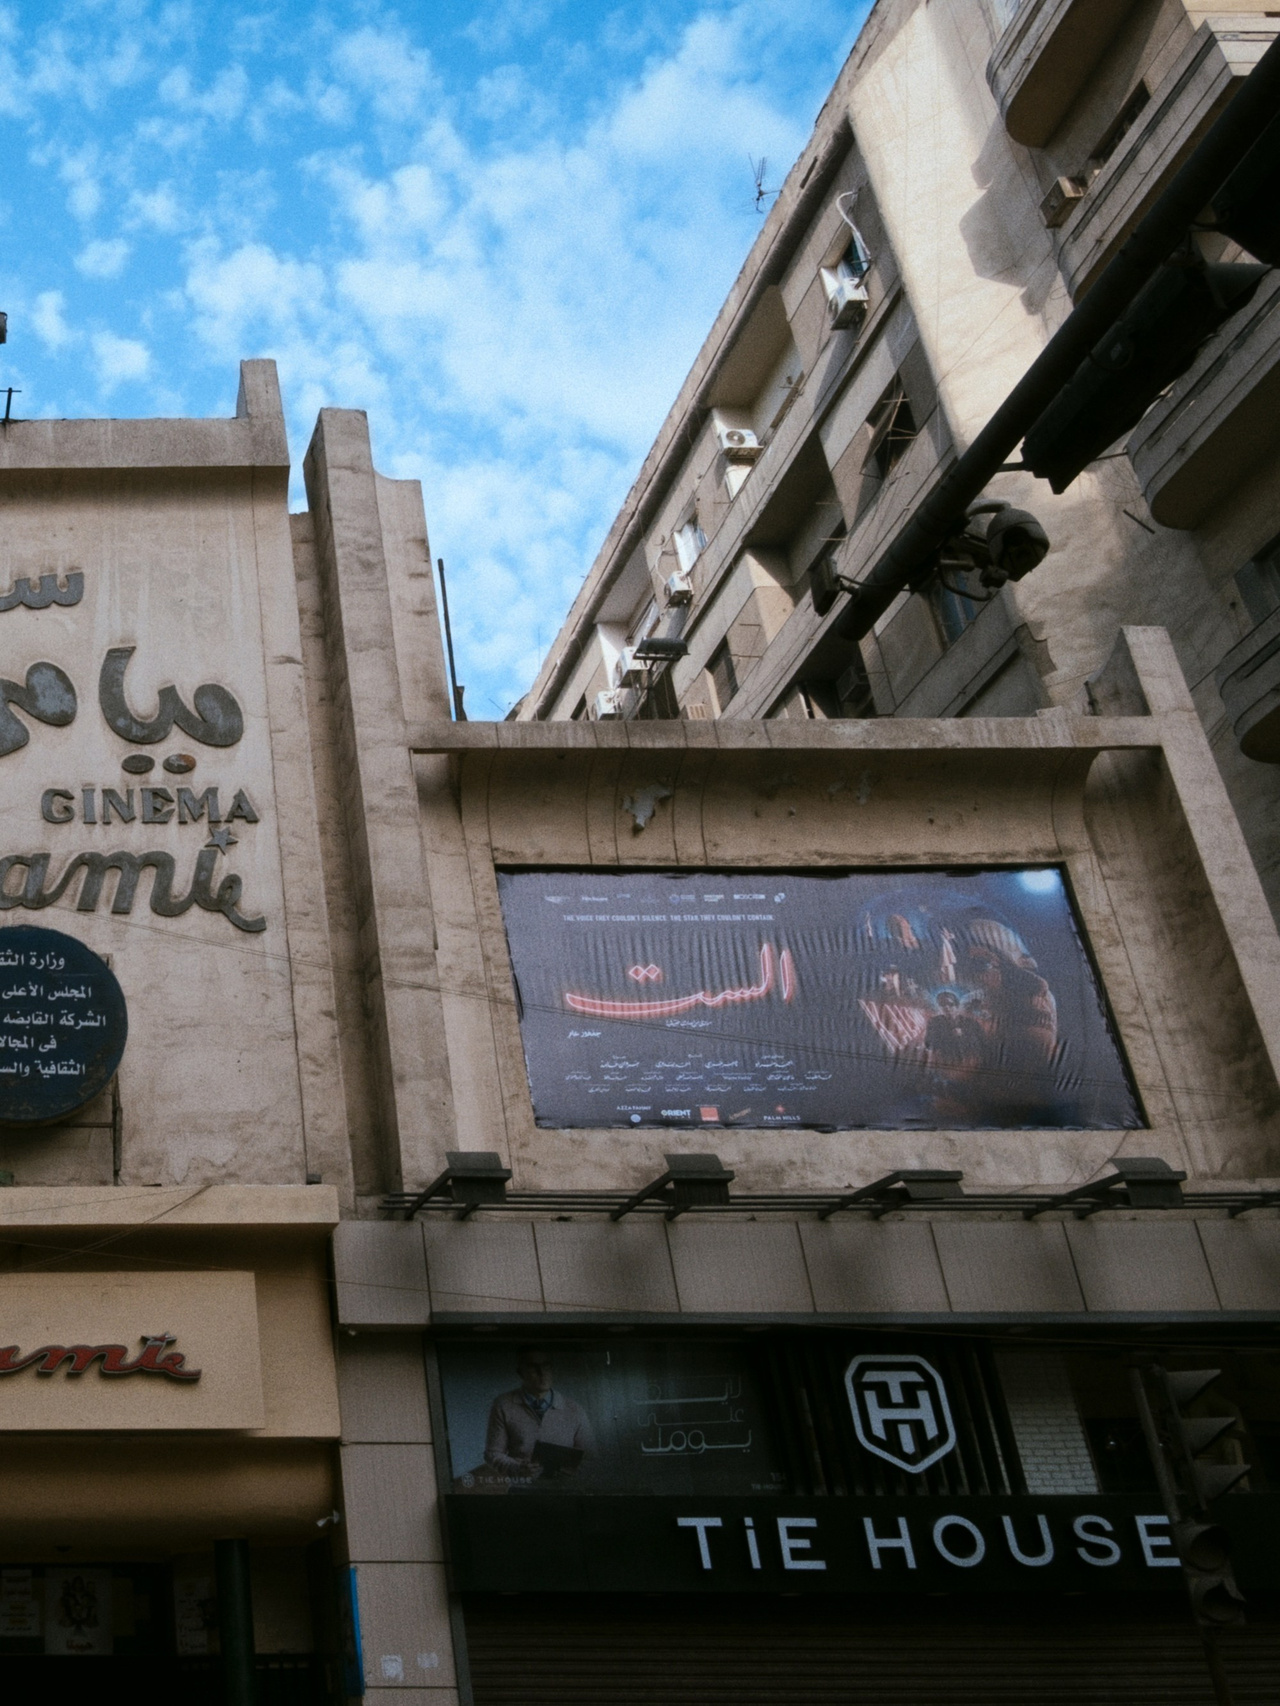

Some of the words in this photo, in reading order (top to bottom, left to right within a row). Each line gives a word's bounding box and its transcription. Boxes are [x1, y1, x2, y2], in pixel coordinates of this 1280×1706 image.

[30, 951, 65, 969] وزارة
[565, 942, 794, 1016] الست
[48, 983, 92, 1003] المجلس
[59, 1009, 106, 1029] الشركة
[34, 1058, 86, 1078] الثقافية
[862, 1513, 1182, 1570] HOUSE
